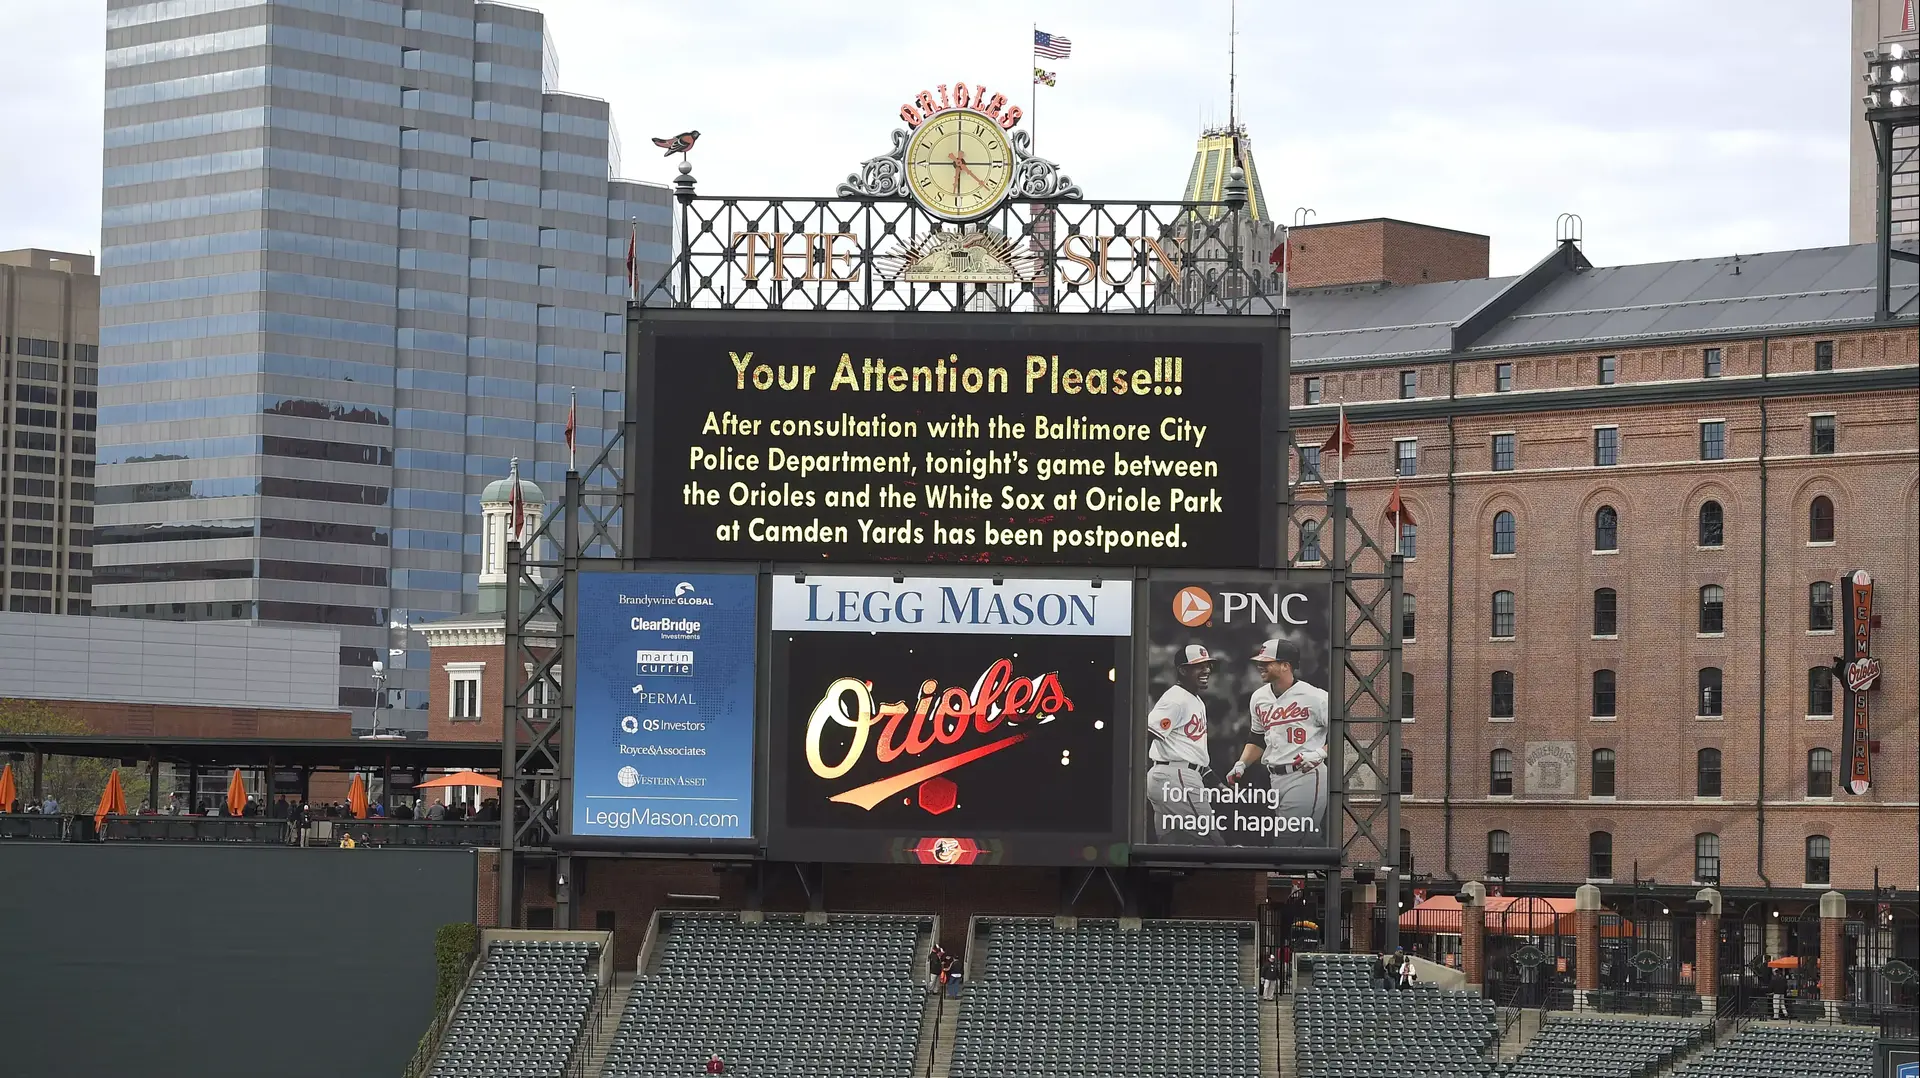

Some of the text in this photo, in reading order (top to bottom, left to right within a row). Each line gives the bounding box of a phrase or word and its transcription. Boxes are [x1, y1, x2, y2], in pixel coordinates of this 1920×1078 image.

[900, 82, 1023, 129] ORIOLES
[732, 232, 1187, 286] THE SUN
[729, 352, 1183, 396] Your Attention Please!!!
[702, 411, 1207, 448] After consultation with the Baltimore City
[690, 446, 1218, 481] Police Department, tonight's game between
[683, 481, 1223, 513] the Orioles and the White Sox at Oriole Park
[716, 518, 1188, 553] at Camden Yards has been postponed.
[805, 584, 1099, 627] LEGG MASON
[1220, 592, 1309, 625] PNC
[631, 617, 701, 634] ClearBridge
[1857, 590, 1868, 653] TEAM
[641, 653, 689, 662] martin
[641, 662, 689, 673] currie
[1850, 660, 1879, 683] Orioles
[640, 692, 697, 705] PERMAL
[643, 719, 706, 731] QS Investors
[806, 658, 1074, 780] Orioles
[1255, 702, 1310, 727] Orioles
[1286, 727, 1307, 744] 19
[1855, 695, 1866, 776] STORE
[676, 776, 707, 787] ASSET
[1162, 781, 1280, 810] for making
[586, 807, 739, 829] LeggMason.com
[1162, 810, 1320, 837] magic happen.
